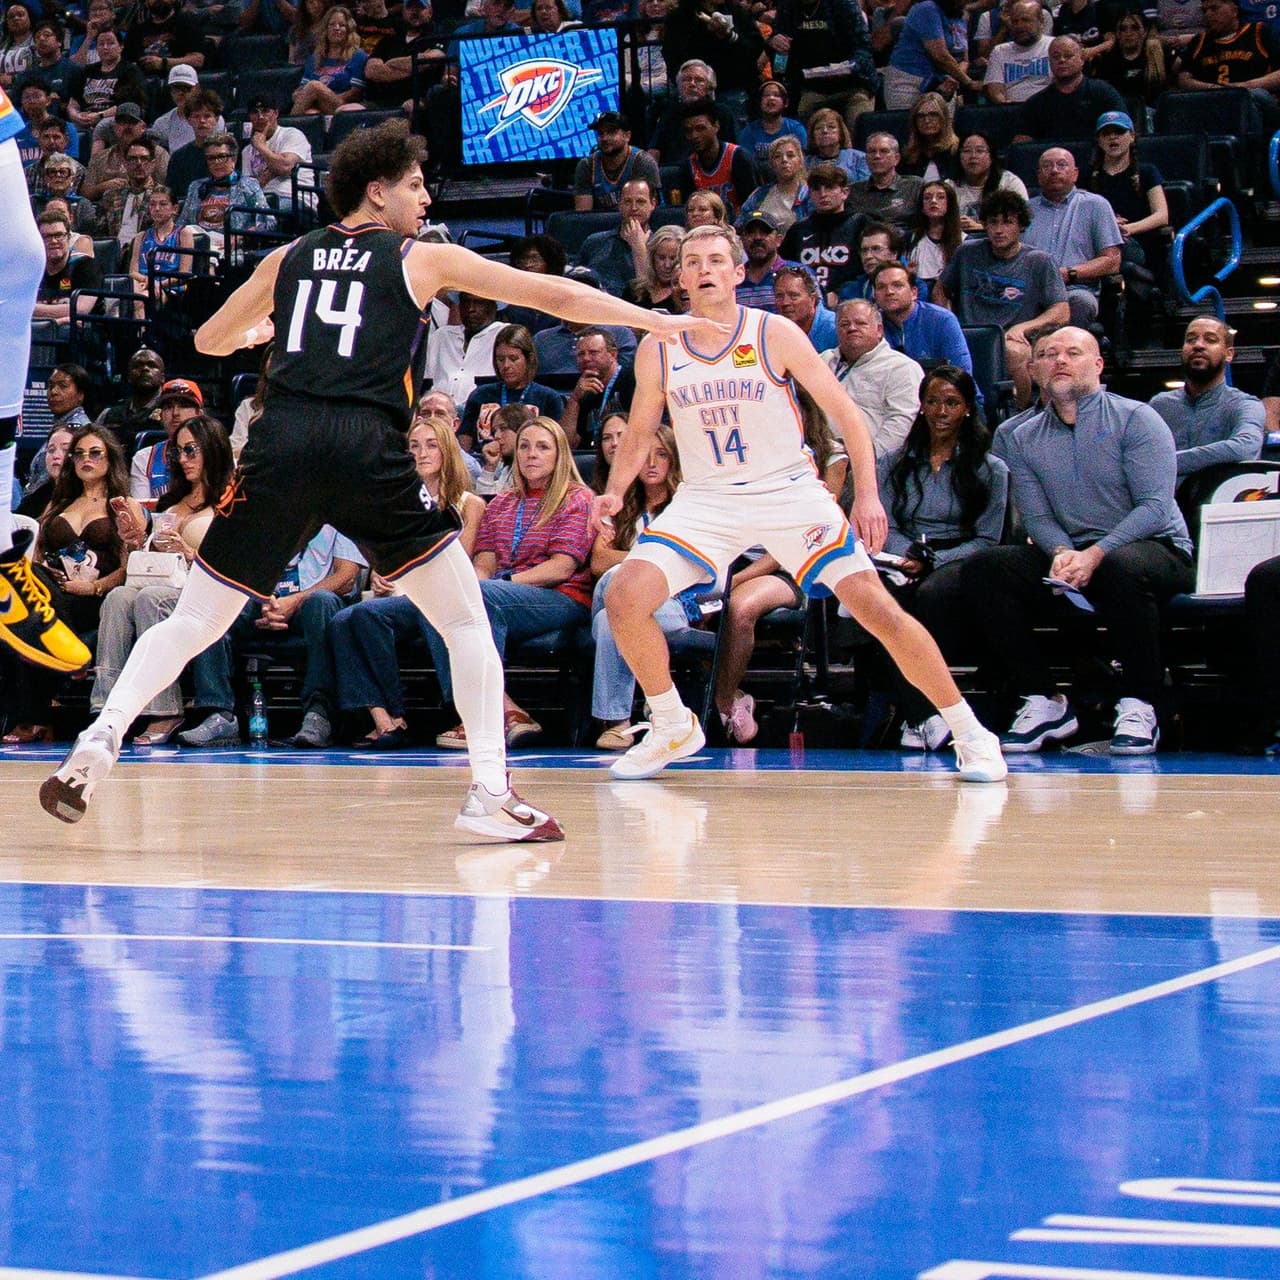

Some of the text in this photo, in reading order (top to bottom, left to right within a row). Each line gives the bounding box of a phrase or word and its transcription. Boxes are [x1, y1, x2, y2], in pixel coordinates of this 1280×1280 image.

[286, 279, 365, 357] 14
[671, 379, 766, 411] OKLAHOMA
[700, 405, 740, 427] CITY
[703, 427, 749, 466] 14
